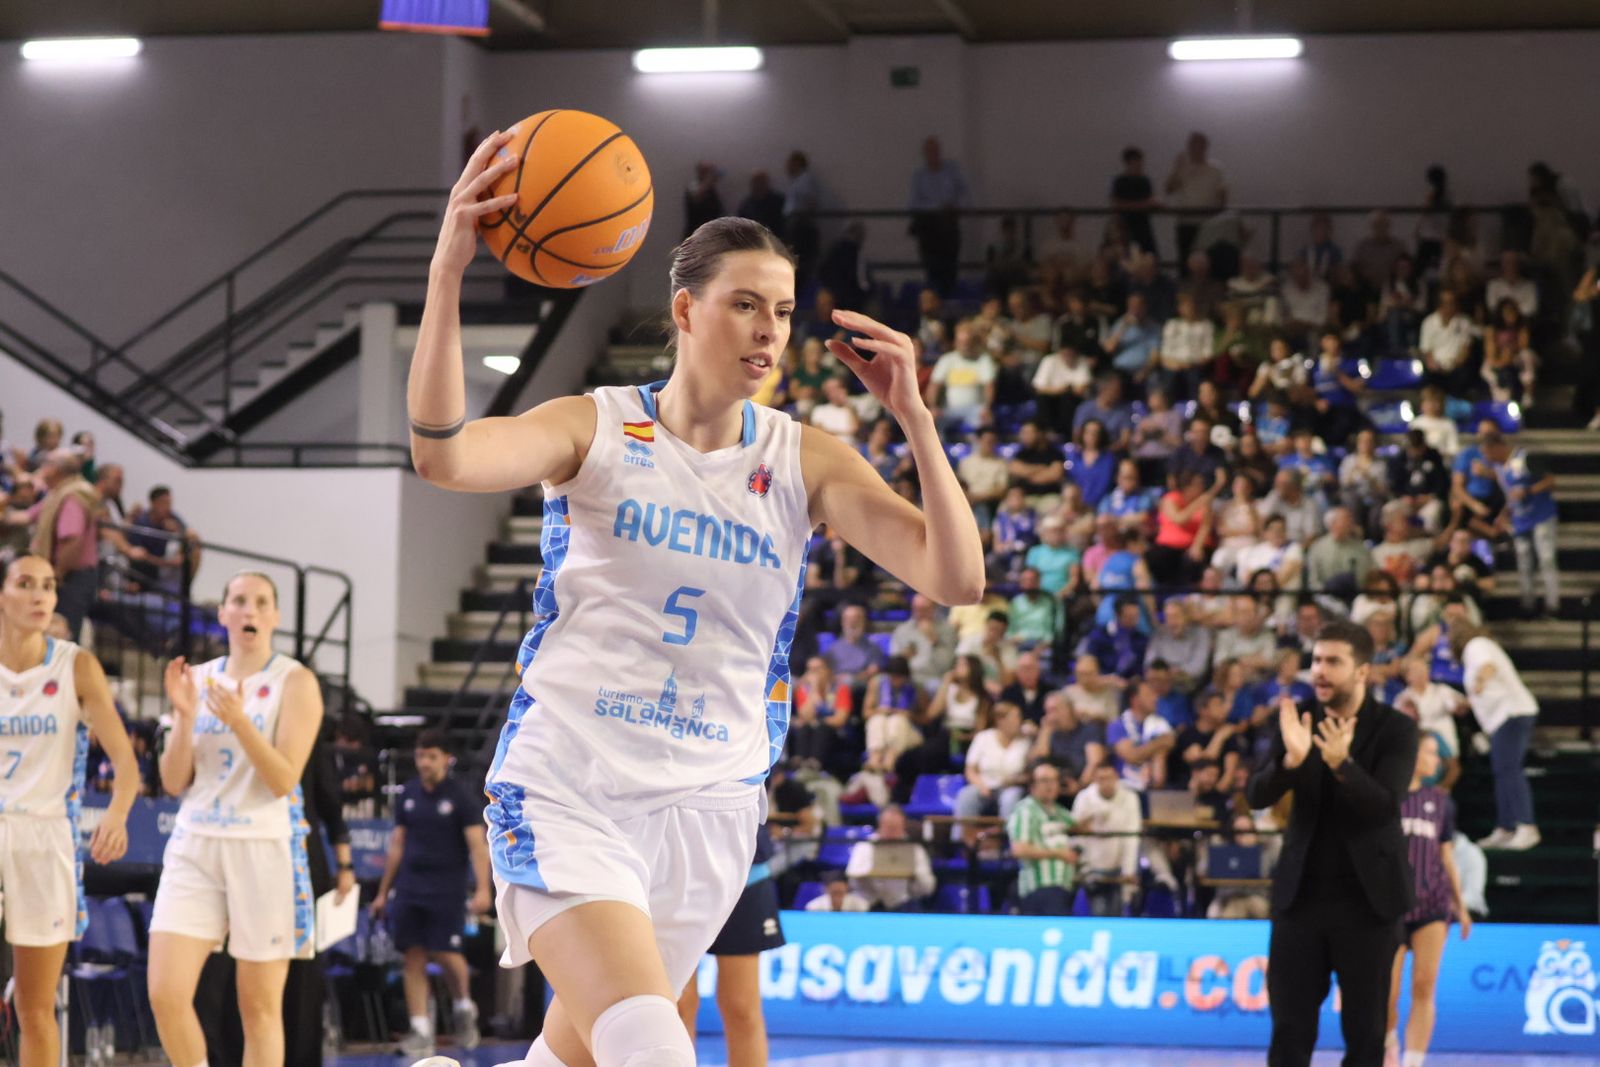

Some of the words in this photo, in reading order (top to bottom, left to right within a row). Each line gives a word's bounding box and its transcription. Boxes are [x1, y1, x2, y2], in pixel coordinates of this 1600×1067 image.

[613, 498, 781, 569] AVENIDA
[662, 585, 706, 646] 5
[598, 686, 643, 704] turismo
[4, 751, 22, 780] 7
[218, 747, 234, 780] 3
